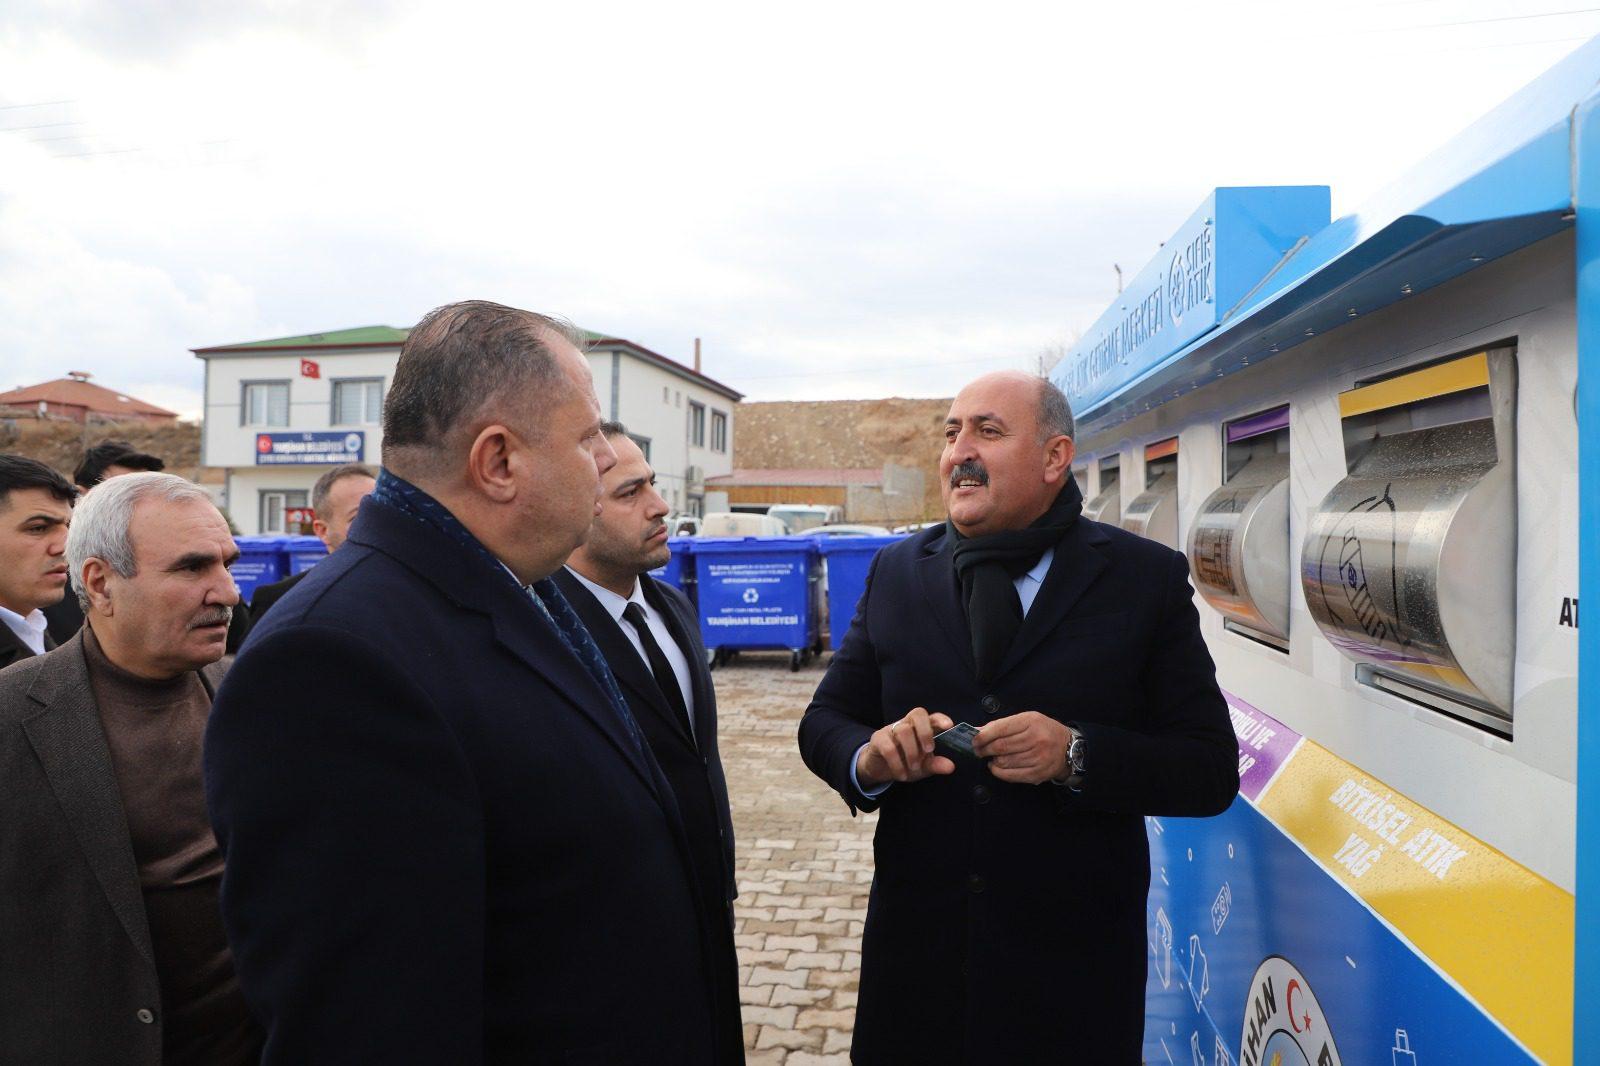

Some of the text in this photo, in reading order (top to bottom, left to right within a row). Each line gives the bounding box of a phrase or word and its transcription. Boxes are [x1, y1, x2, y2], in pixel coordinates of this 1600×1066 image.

[1186, 227, 1211, 276] SIFIR
[1186, 261, 1211, 311] ATIK
[1121, 272, 1164, 359] MERKEZİ
[749, 614, 798, 625] BELEDİYESİ
[1328, 778, 1468, 880] BİTKİSEL ATIK
[1332, 832, 1387, 878] YAĞ
